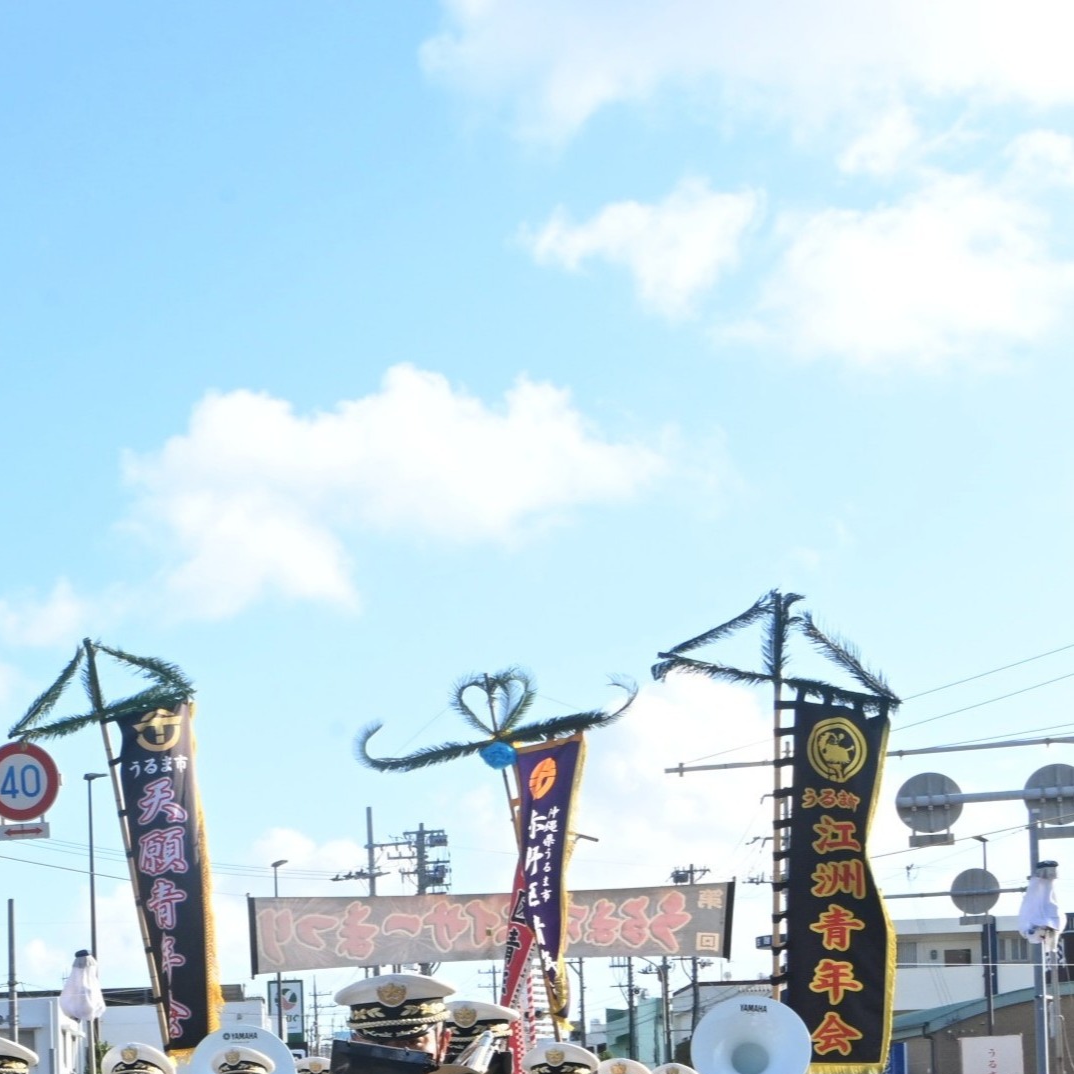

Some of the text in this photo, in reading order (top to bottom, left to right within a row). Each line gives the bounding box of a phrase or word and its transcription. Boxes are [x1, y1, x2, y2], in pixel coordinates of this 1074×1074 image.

[129, 754, 188, 779] うるま市
[0, 764, 41, 799] 40
[809, 815, 867, 1057] 江洲青年会
[740, 1004, 767, 1013] YAMAHA
[230, 1032, 258, 1040] YAMAHA
